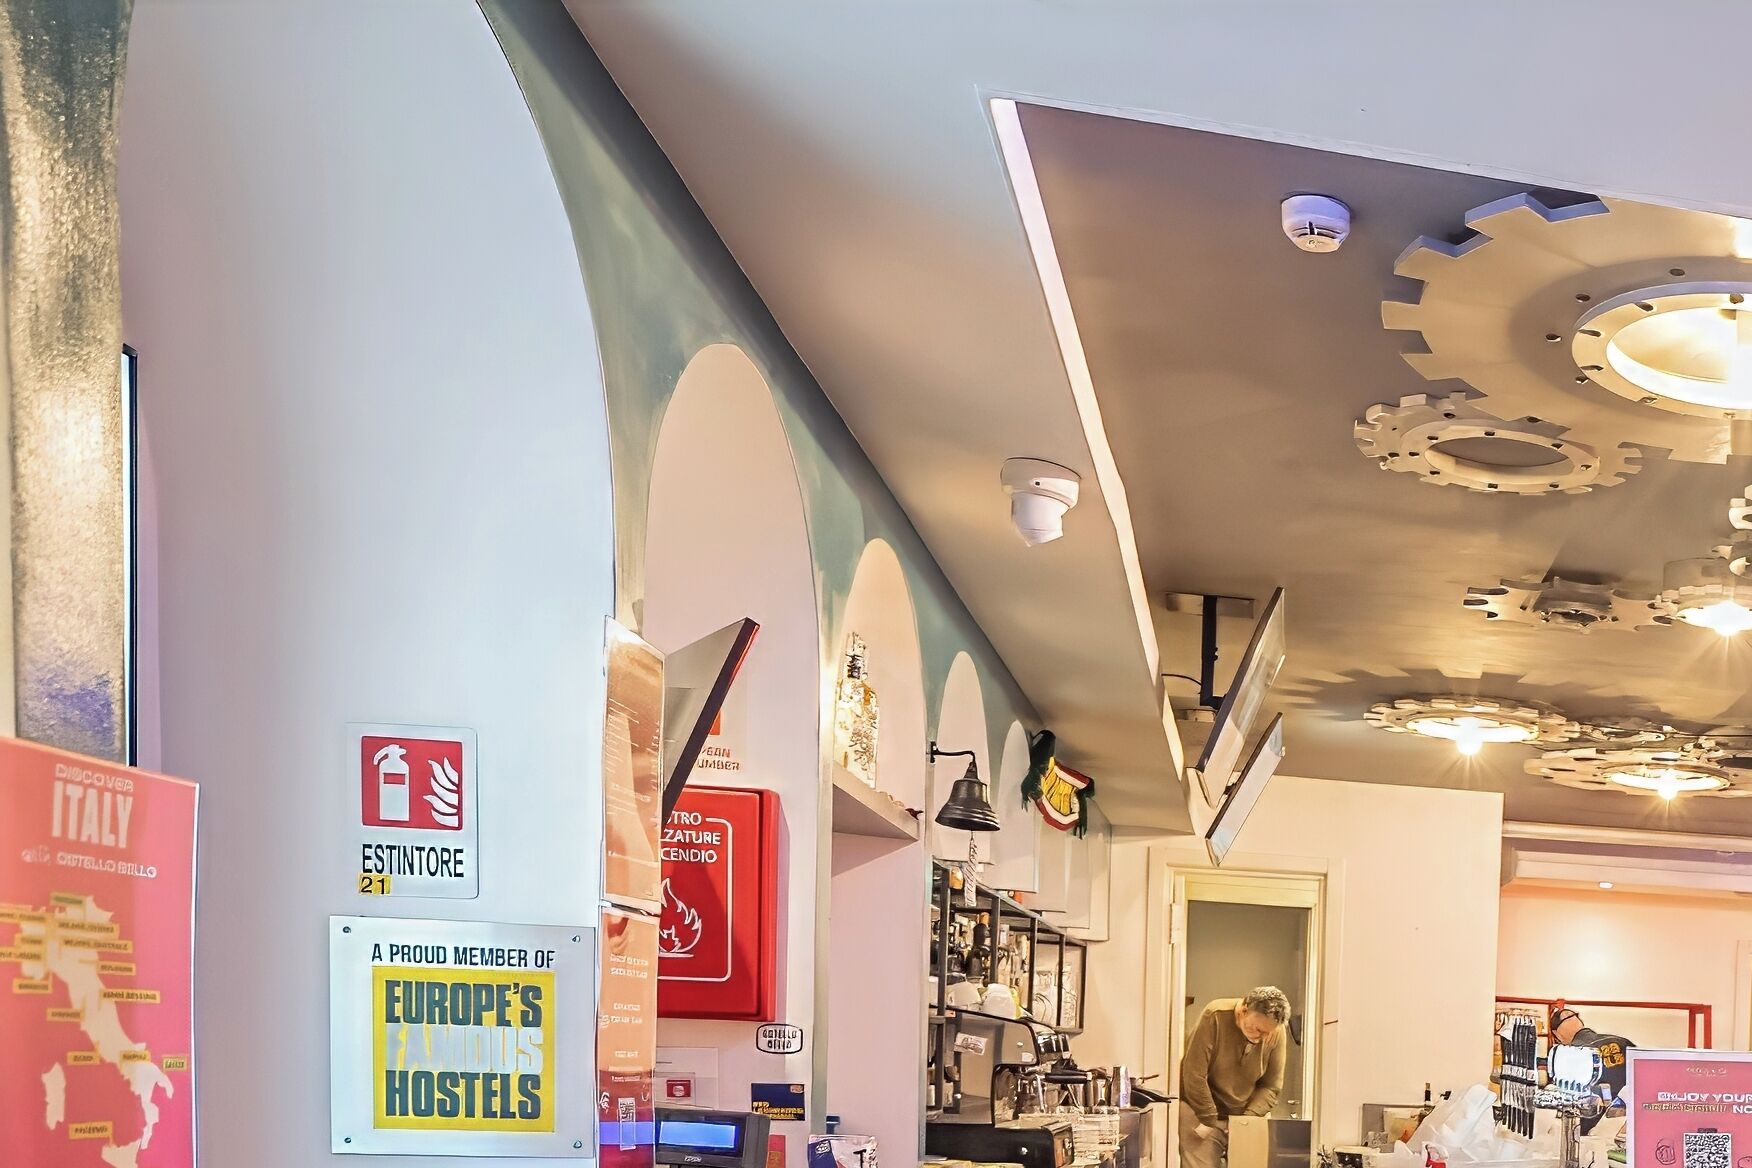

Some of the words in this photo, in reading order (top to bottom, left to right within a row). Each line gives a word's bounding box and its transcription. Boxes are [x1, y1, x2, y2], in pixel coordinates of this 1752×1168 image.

[55, 763, 134, 793] DISCOVER
[52, 780, 133, 849] ITALY
[667, 810, 702, 825] TRO
[664, 829, 721, 845] ZATURE
[362, 843, 465, 878] ESTINTORE
[660, 847, 718, 863] CENDIO
[360, 876, 388, 895] 21
[371, 943, 383, 962] A
[389, 944, 447, 964] PROUD
[453, 946, 528, 968] MEMBER
[535, 949, 555, 969] OF
[385, 979, 543, 1028] EUROPE'S
[385, 1023, 544, 1075] FAMOUS
[385, 1070, 542, 1120] HOSTELS
